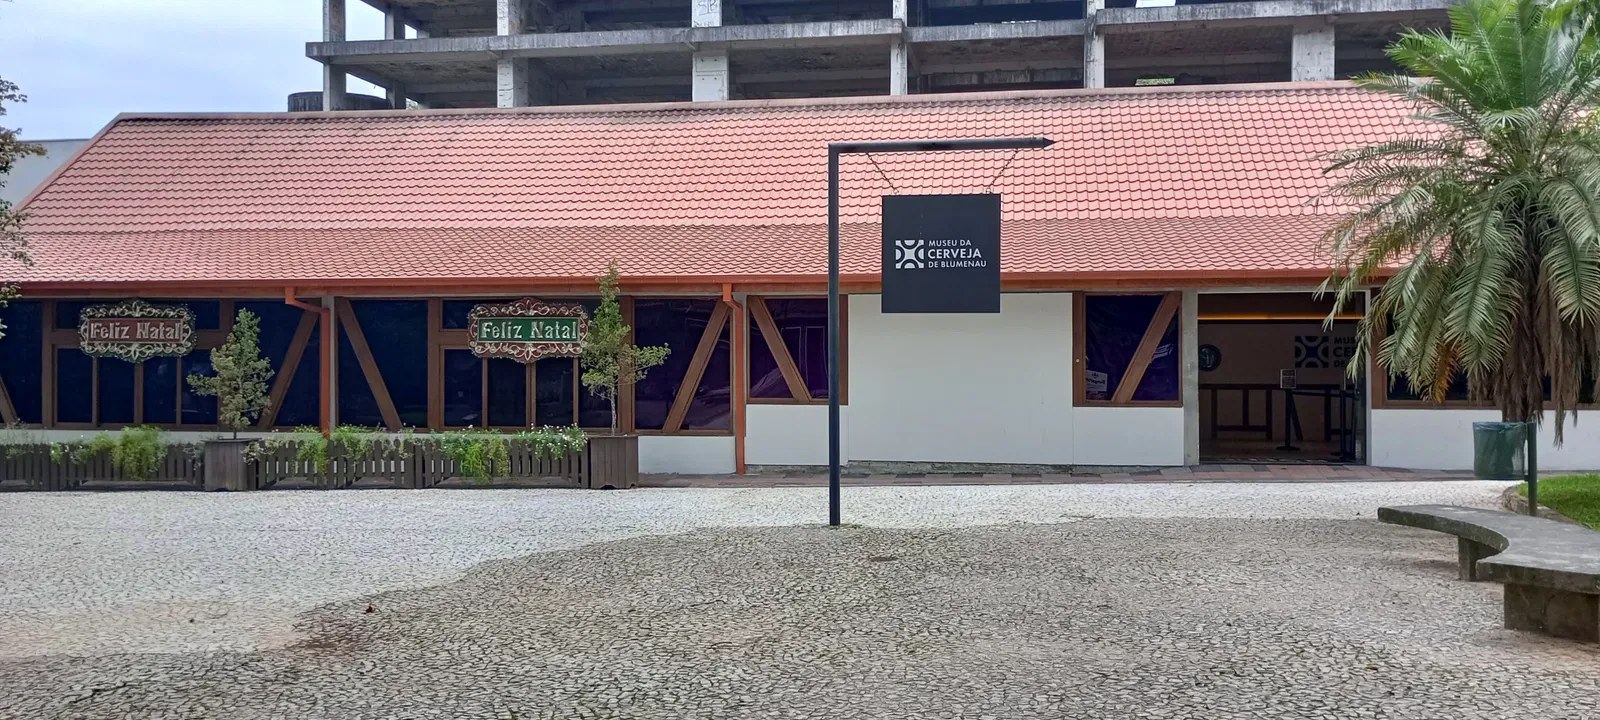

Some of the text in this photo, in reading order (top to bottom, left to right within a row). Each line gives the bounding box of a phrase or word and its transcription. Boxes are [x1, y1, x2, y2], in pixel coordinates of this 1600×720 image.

[928, 239, 957, 247] MUSEU
[927, 248, 982, 259] CERVEJA
[940, 260, 987, 268] BLUMENAU
[90, 322, 181, 340] Feliz Natal
[480, 321, 577, 339] Feliz Natal
